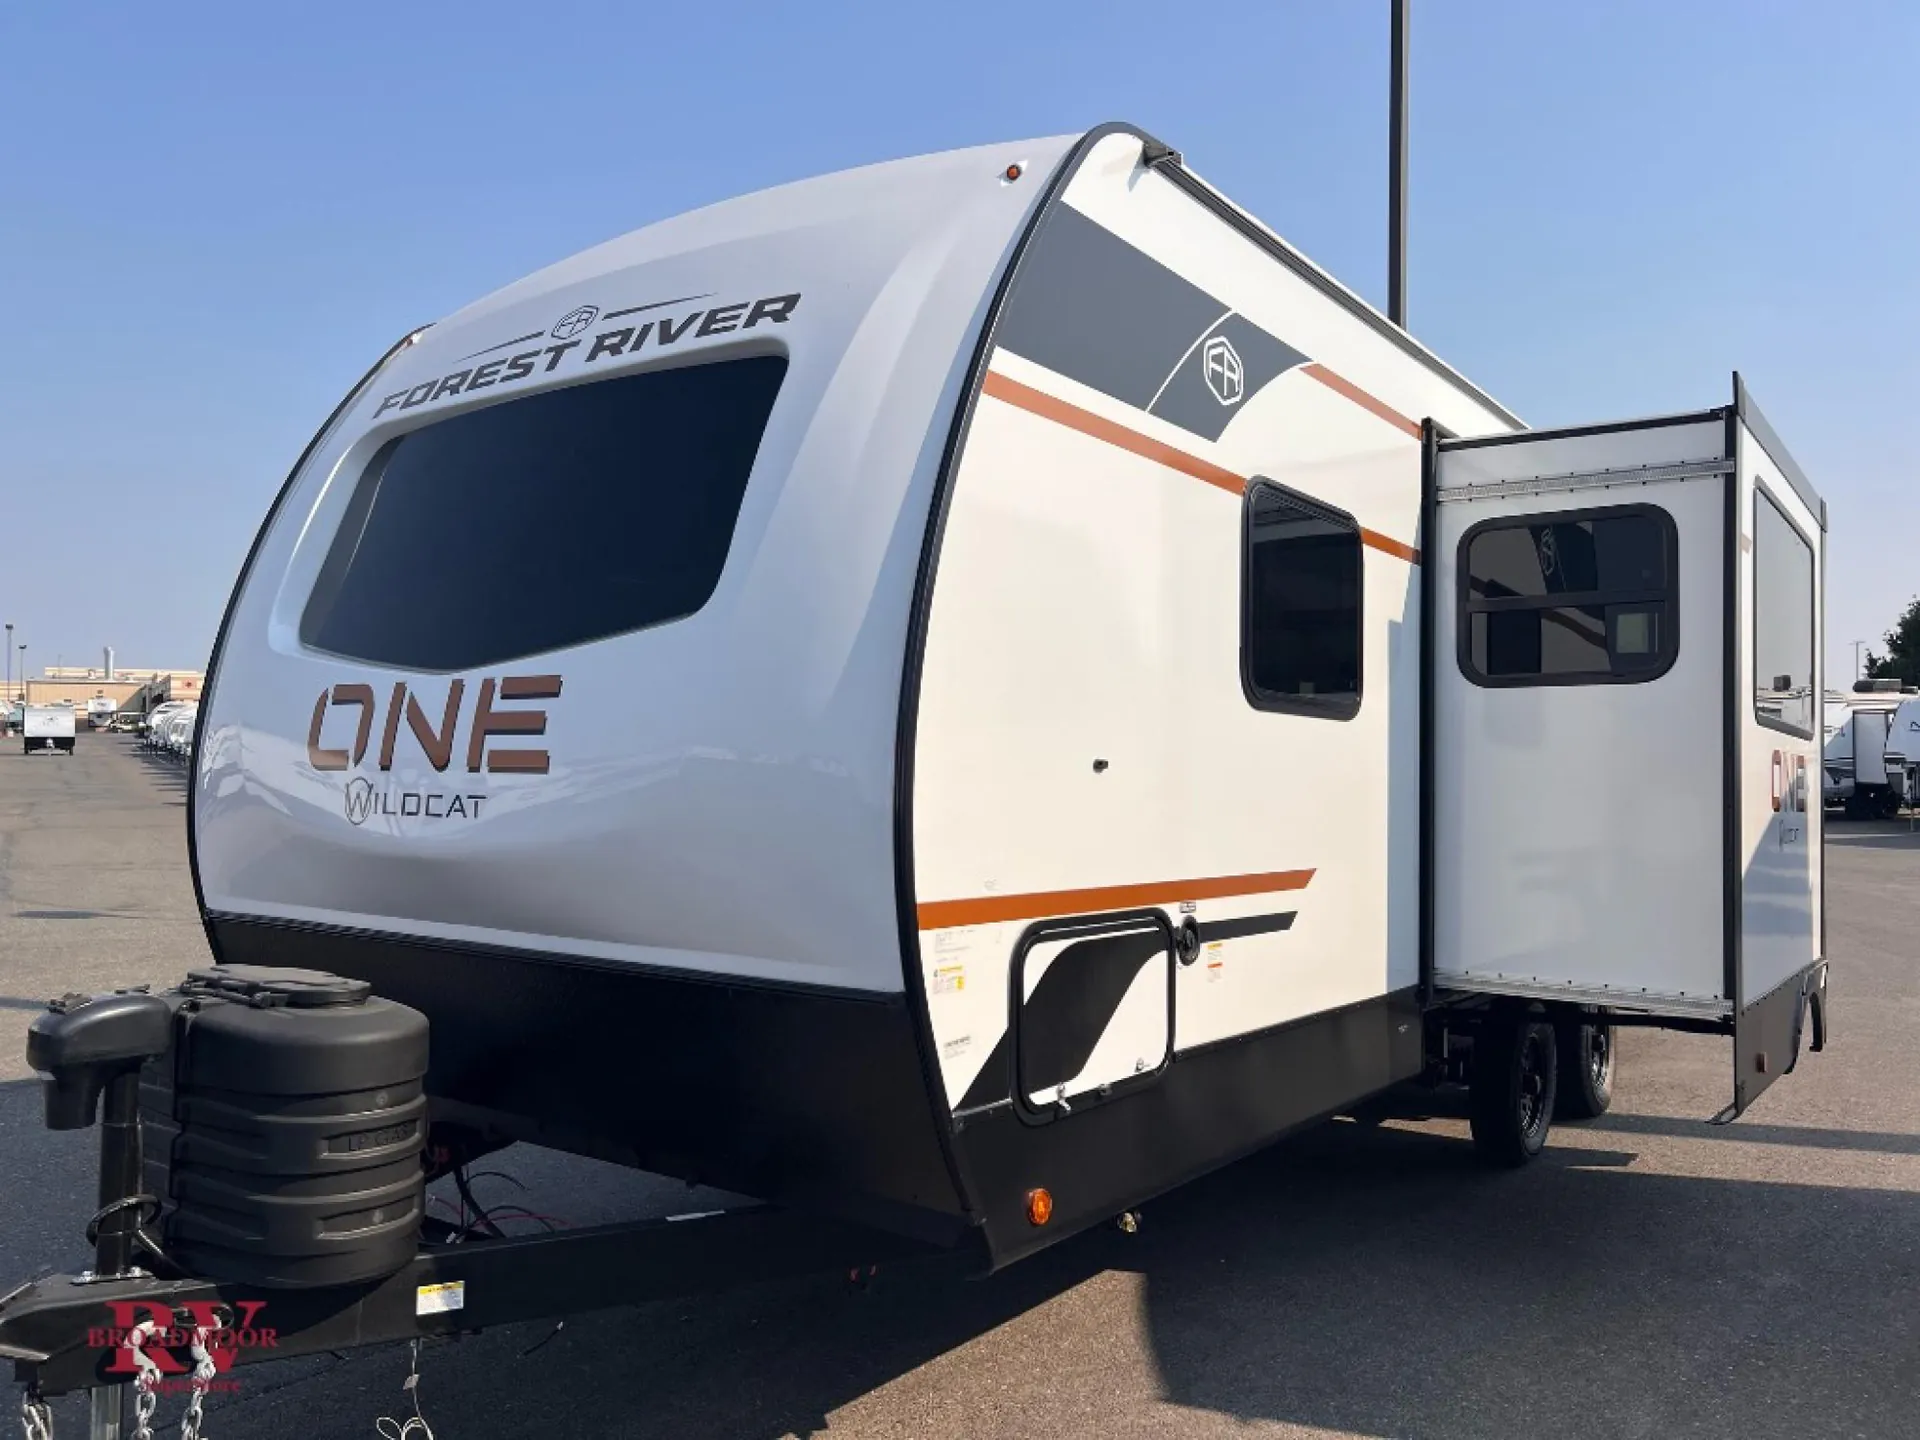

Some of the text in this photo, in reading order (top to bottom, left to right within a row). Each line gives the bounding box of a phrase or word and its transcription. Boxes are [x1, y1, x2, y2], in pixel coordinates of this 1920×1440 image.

[373, 292, 802, 419] FOREST RIVER
[307, 675, 563, 775] ONE
[345, 777, 488, 825] WILDCAT
